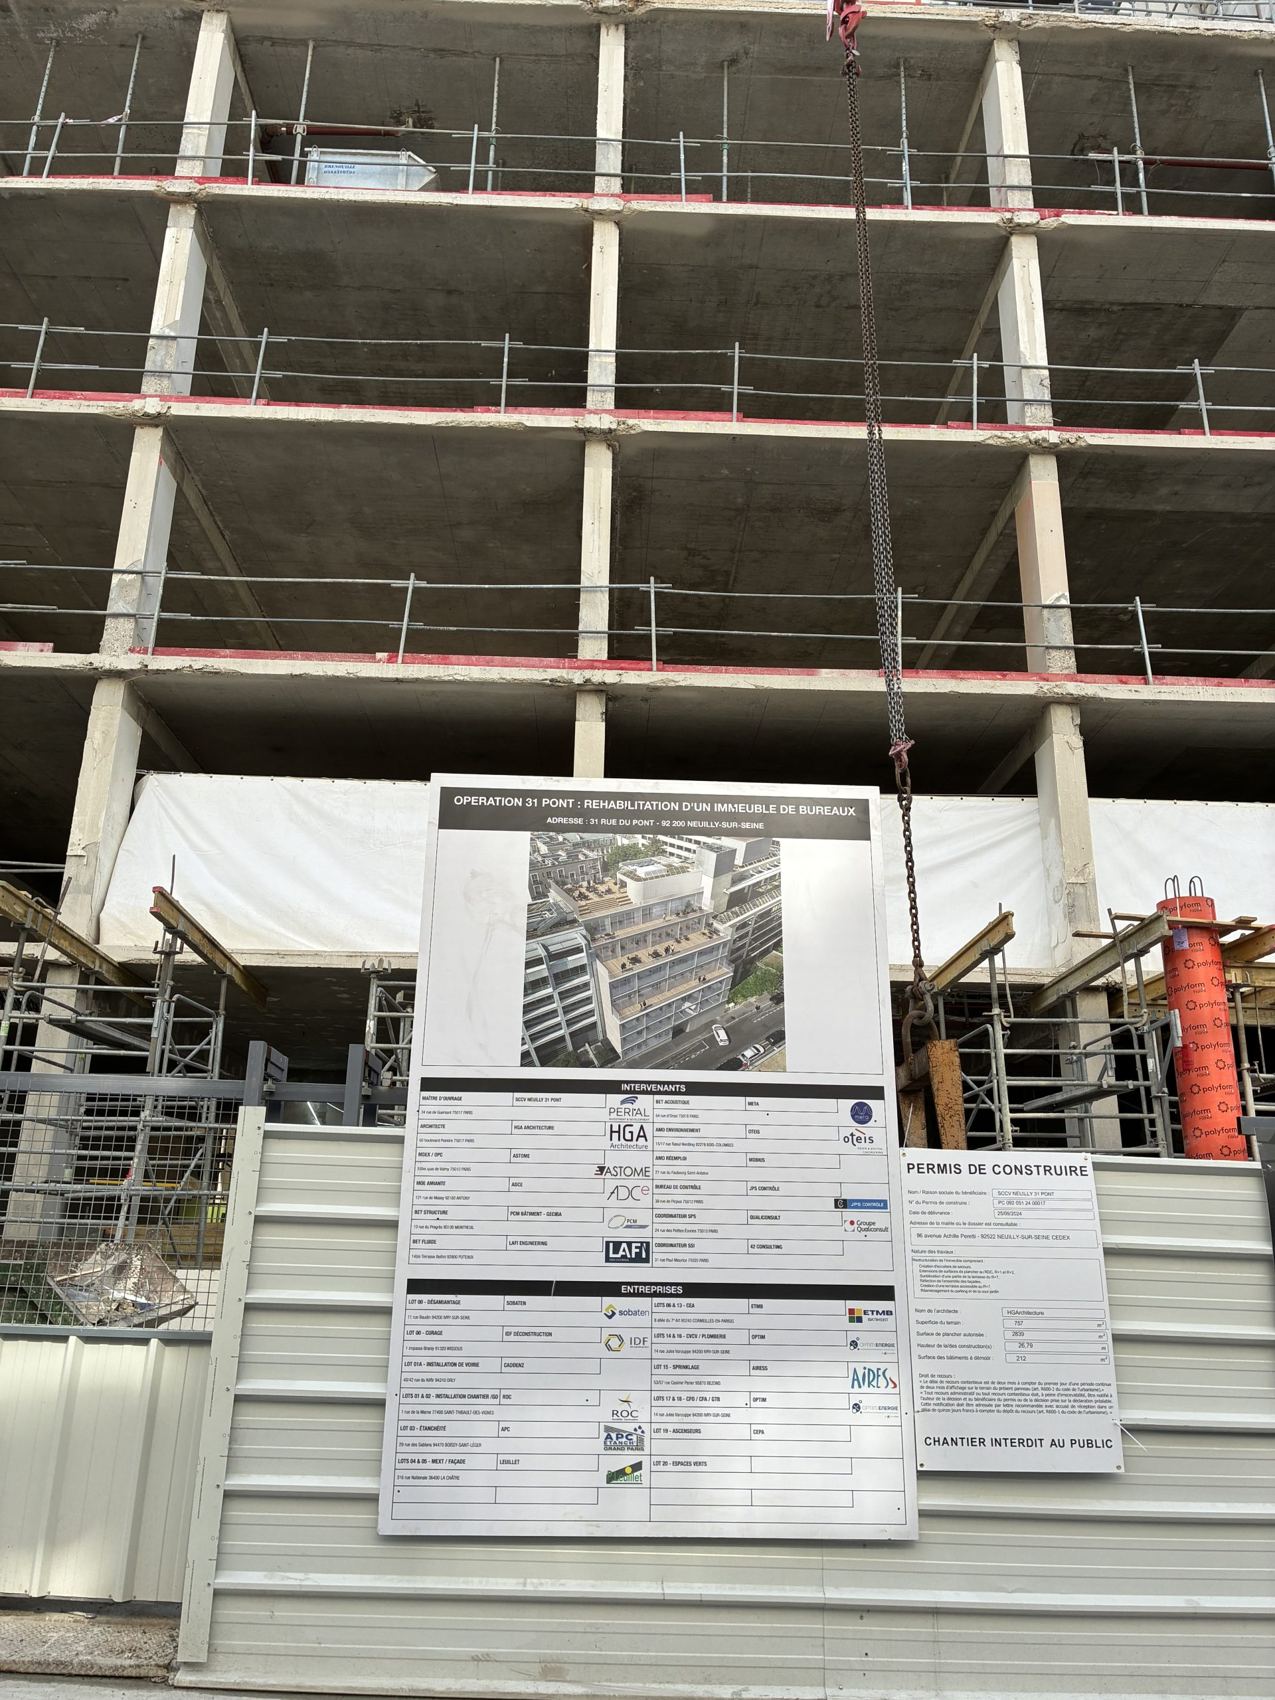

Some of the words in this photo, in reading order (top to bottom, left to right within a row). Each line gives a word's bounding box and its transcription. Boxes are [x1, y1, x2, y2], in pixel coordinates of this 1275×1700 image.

[454, 795, 522, 807] OPERATION
[525, 797, 538, 807] 31
[542, 798, 574, 809] PONT
[577, 800, 581, 808] :
[584, 799, 679, 811] REHABILITATION
[682, 802, 711, 812] D'UN
[714, 802, 777, 814] IMMEUBLE
[780, 805, 796, 814] DE
[799, 805, 856, 816] BUREAUX
[546, 816, 583, 825] ADRESSE
[600, 818, 617, 826] RUE
[672, 820, 685, 828] 200
[687, 821, 765, 829] NEUILLY-SUR-SEINE
[621, 1083, 686, 1092] INTERVENANTS
[608, 1107, 650, 1117] PERIAL
[610, 1123, 648, 1142] HGA
[1204, 1127, 1237, 1138] polyform
[604, 1166, 651, 1177] ASTOME
[907, 1163, 962, 1175] PERMIS
[968, 1164, 987, 1175] DE
[992, 1164, 1089, 1177] CONSTRUIRE
[621, 1285, 683, 1294] ENTREPRISES
[618, 1308, 649, 1316] sobaten
[629, 1336, 648, 1346] IDF
[611, 1409, 639, 1418] ROC
[604, 1433, 633, 1441] APC
[924, 1436, 986, 1448] CHANTIER
[990, 1437, 1044, 1448] INTERDIT
[1049, 1439, 1065, 1448] AU
[1070, 1438, 1114, 1449] PUBLIC
